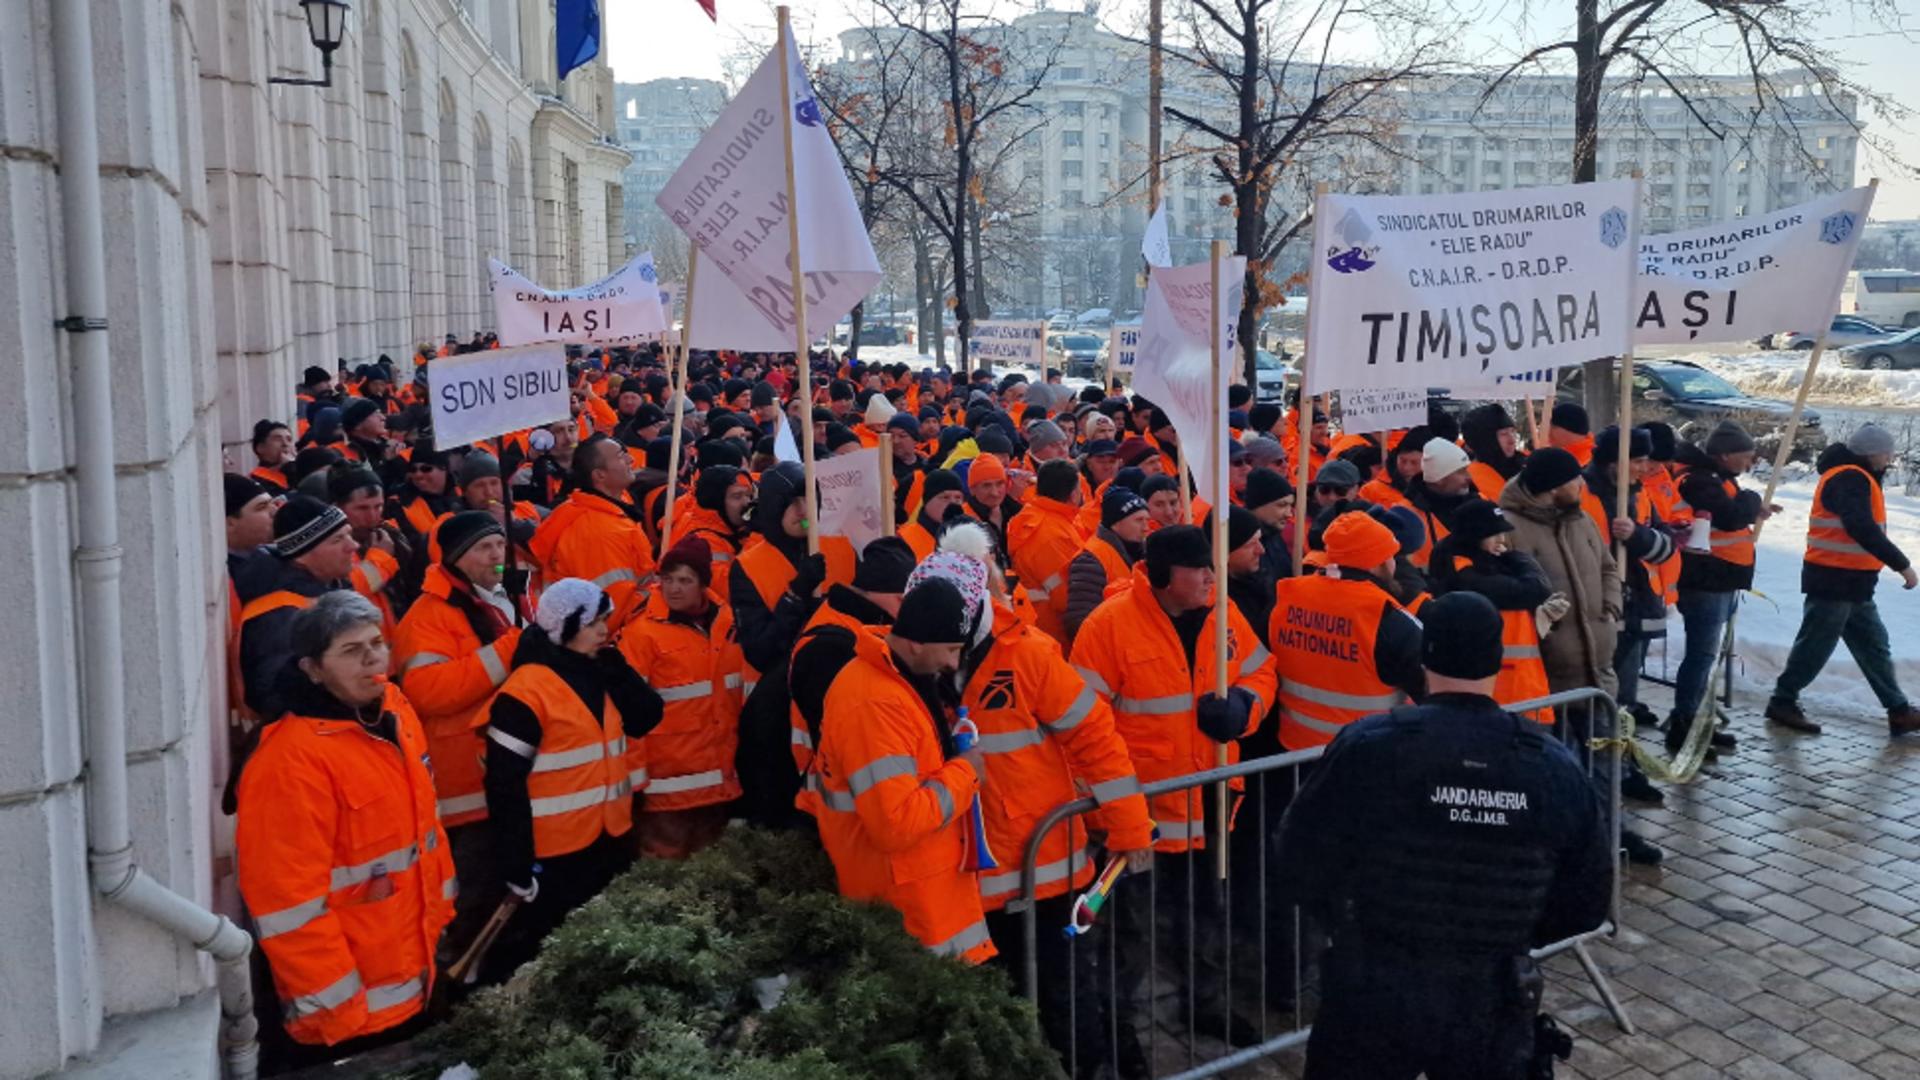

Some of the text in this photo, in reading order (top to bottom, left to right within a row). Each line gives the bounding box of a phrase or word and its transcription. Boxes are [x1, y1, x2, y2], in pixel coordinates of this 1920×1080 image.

[1377, 201, 1587, 232] SINDICATUL DRUMARILOR
[1667, 214, 1803, 252] DRUMARILOR
[1409, 266, 1482, 288] C.N.A.I.R.
[1501, 256, 1574, 281] D.R.D.P.
[543, 308, 611, 338] IAȘI
[1361, 290, 1600, 373] TIMIȘOARA
[441, 367, 561, 413] SDN SIBIU
[1287, 604, 1353, 637] DRUMURI
[1278, 627, 1360, 663] NATIONALE
[1430, 785, 1528, 810] JANDARMERIA
